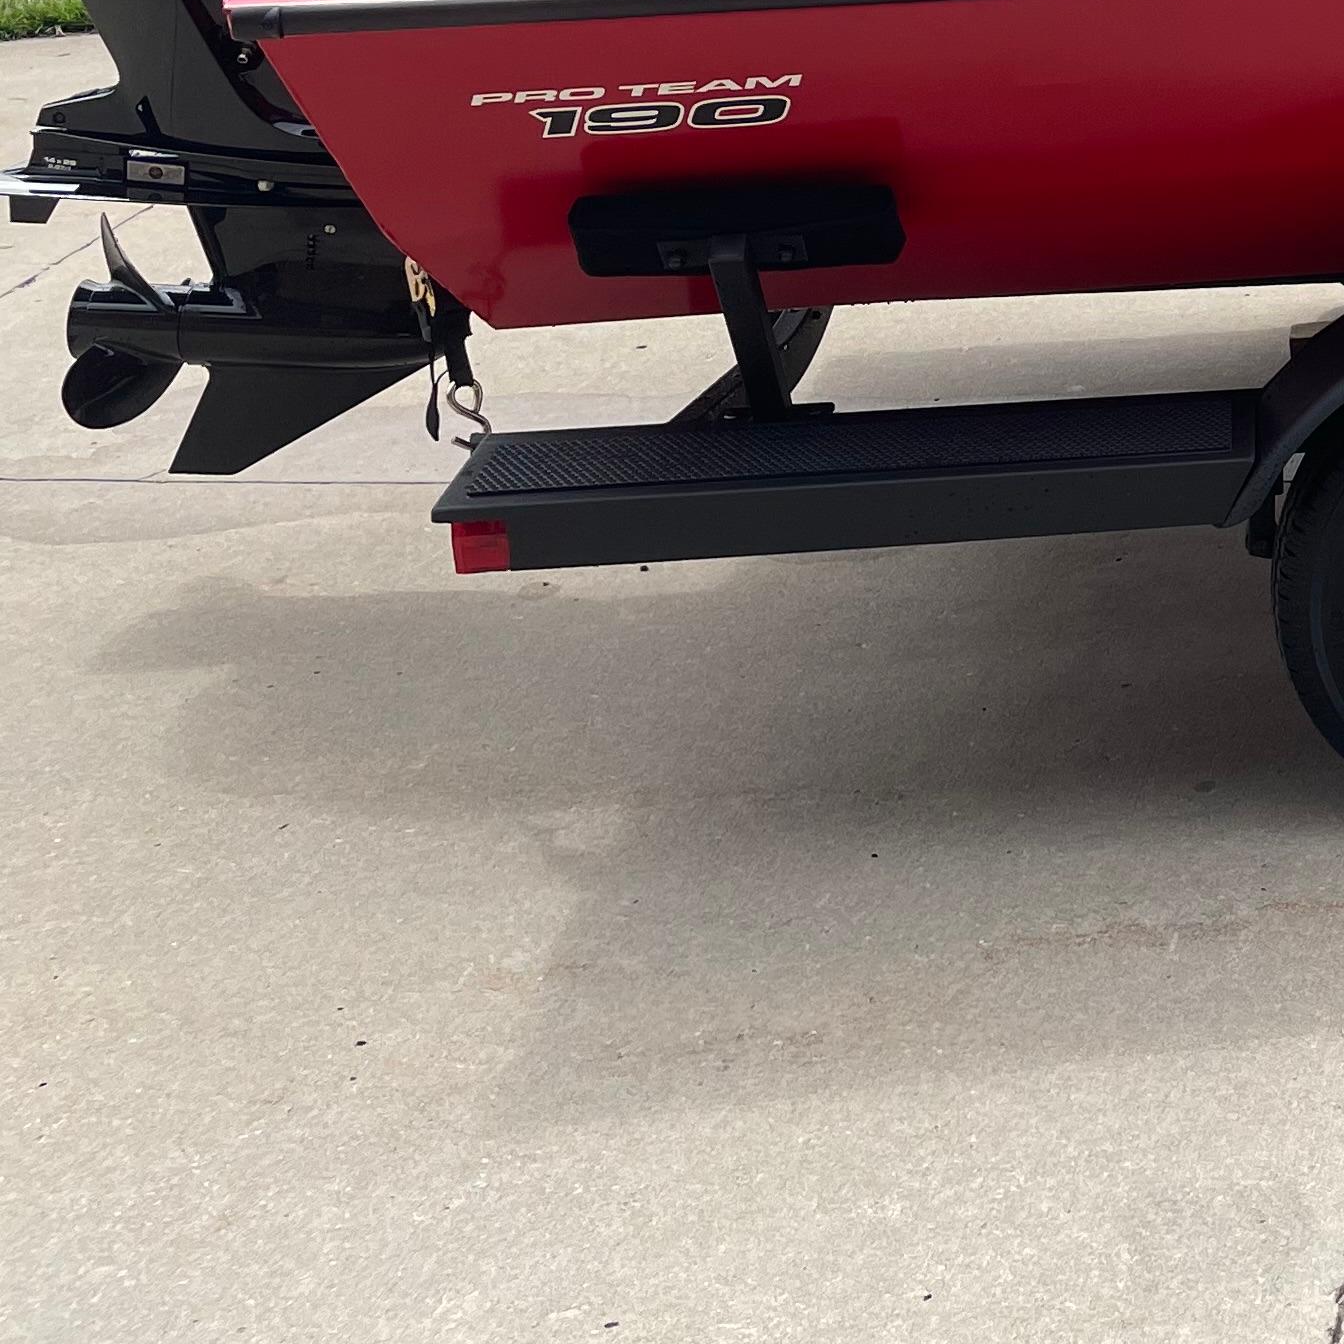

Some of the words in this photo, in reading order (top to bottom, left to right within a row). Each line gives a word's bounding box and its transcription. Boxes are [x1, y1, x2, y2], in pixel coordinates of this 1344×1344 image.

[470, 87, 605, 107] PRO
[618, 73, 803, 97] TEAM
[529, 95, 791, 139] 190
